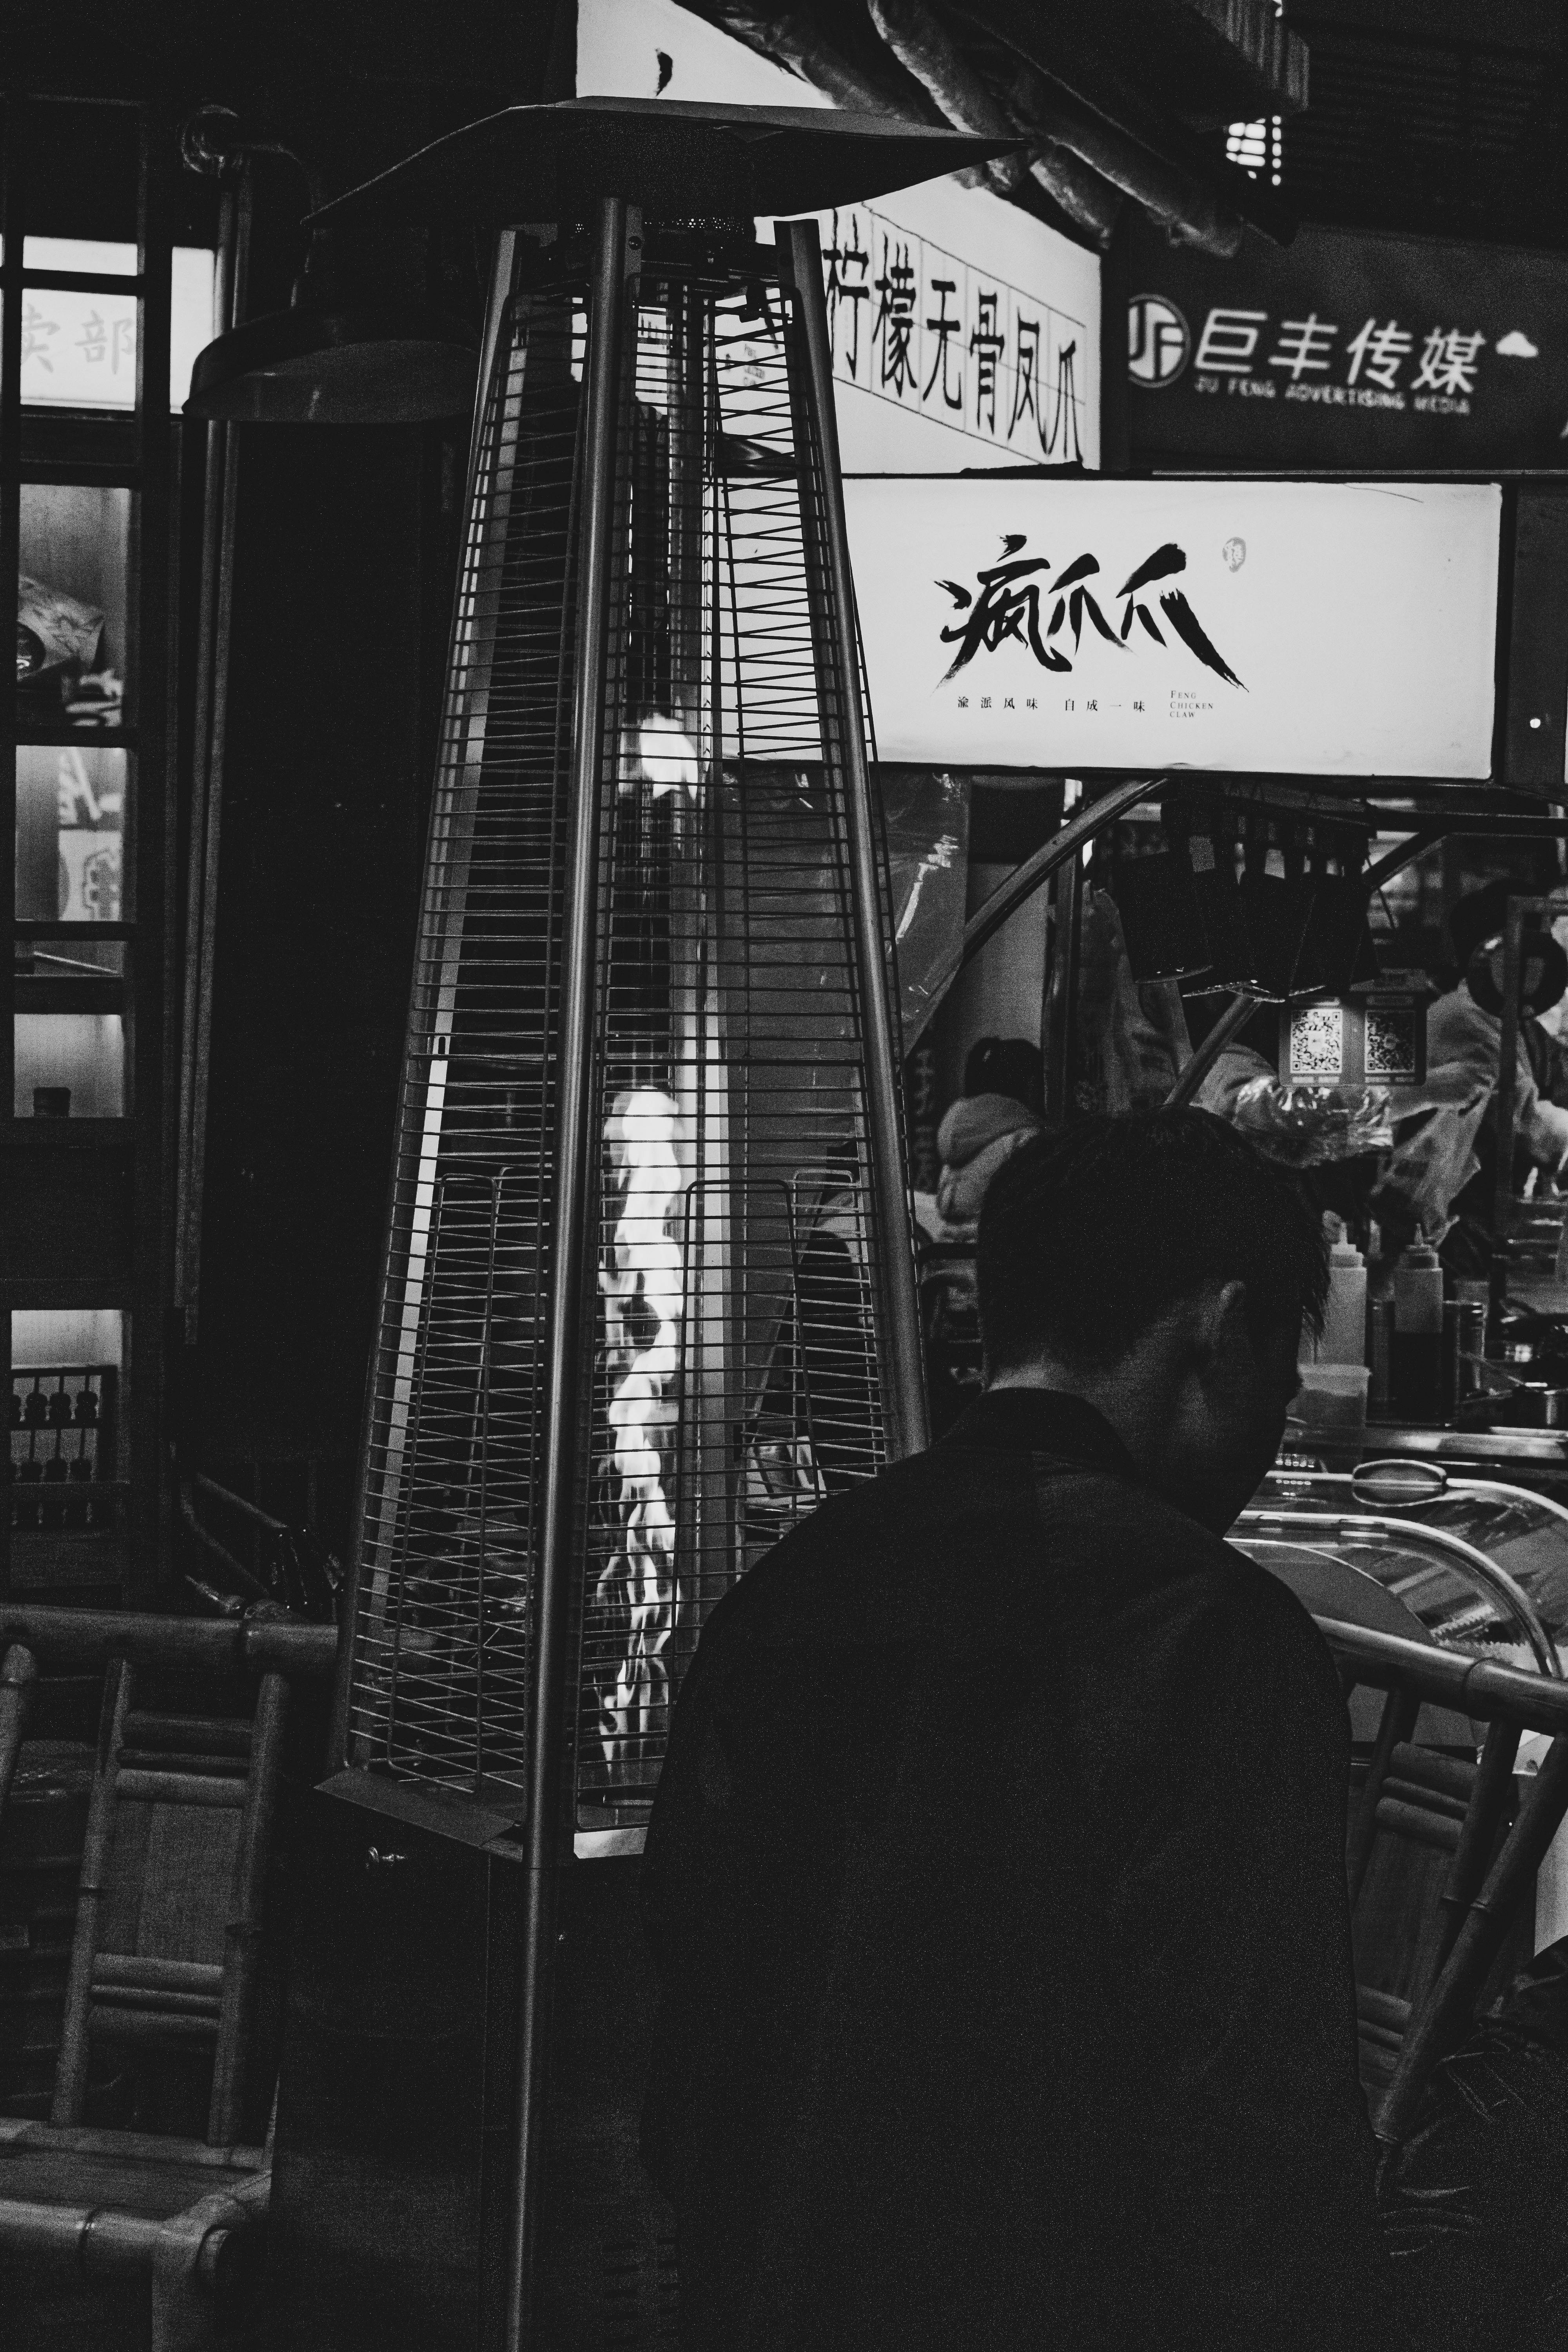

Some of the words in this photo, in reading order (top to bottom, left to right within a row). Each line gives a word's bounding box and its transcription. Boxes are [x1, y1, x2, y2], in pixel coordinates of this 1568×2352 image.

[821, 207, 1083, 463] 柠檬无骨凤爪
[1194, 308, 1486, 395] 巨丰传媒
[1227, 377, 1276, 399] FENG
[1285, 383, 1405, 410] ADVERTISING
[1414, 395, 1471, 416] MEDIA
[932, 534, 1250, 694] 疯爪爪
[1065, 699, 1145, 713] 自成一味
[1170, 701, 1214, 710] CHICKEN
